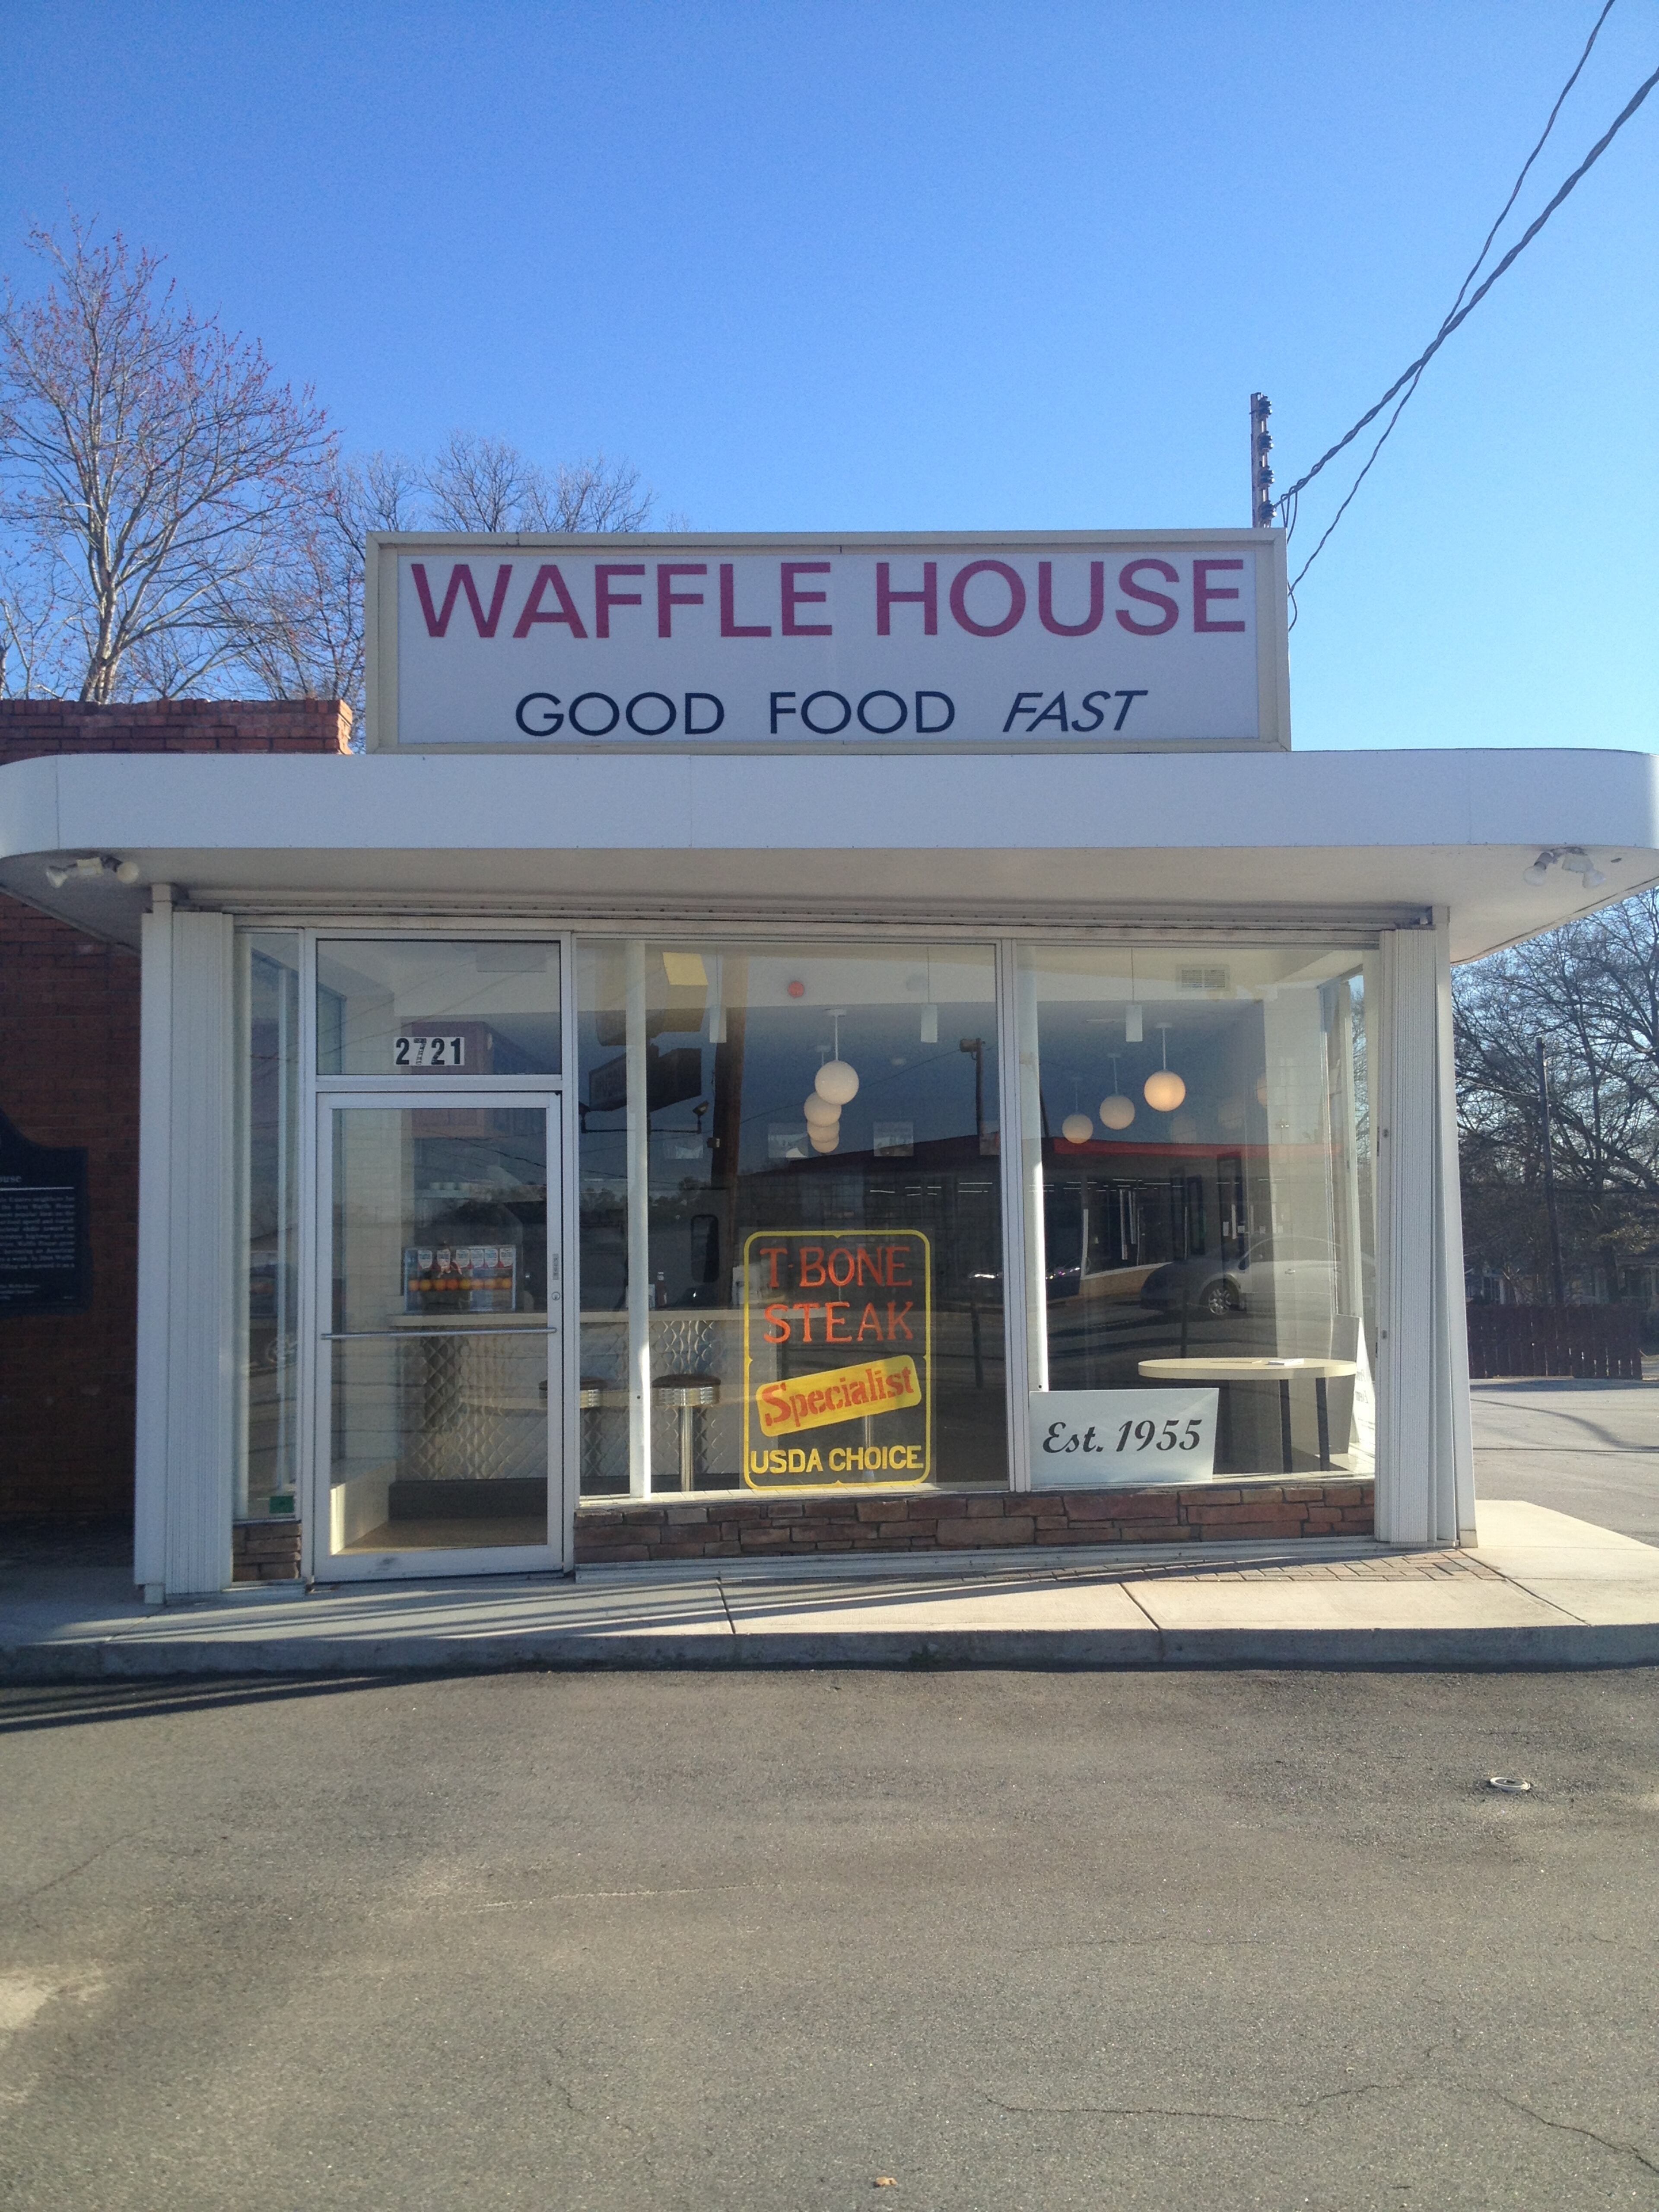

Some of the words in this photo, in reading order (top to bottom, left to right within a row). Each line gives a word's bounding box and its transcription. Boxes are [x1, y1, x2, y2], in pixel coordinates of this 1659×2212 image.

[411, 563, 833, 638] WAFFLE
[876, 559, 1246, 638] HOUSE
[515, 692, 726, 737] GOOD
[770, 690, 956, 734] FOOD
[1002, 690, 1149, 734] FAST
[395, 1038, 461, 1065] 2721
[763, 1301, 914, 1343] STEAK
[761, 1367, 914, 1427] Specialist
[1042, 1422, 1103, 1453] Est.
[1116, 1419, 1202, 1452] 1955
[750, 1448, 823, 1473] USDA
[829, 1445, 923, 1471] CHOICE
